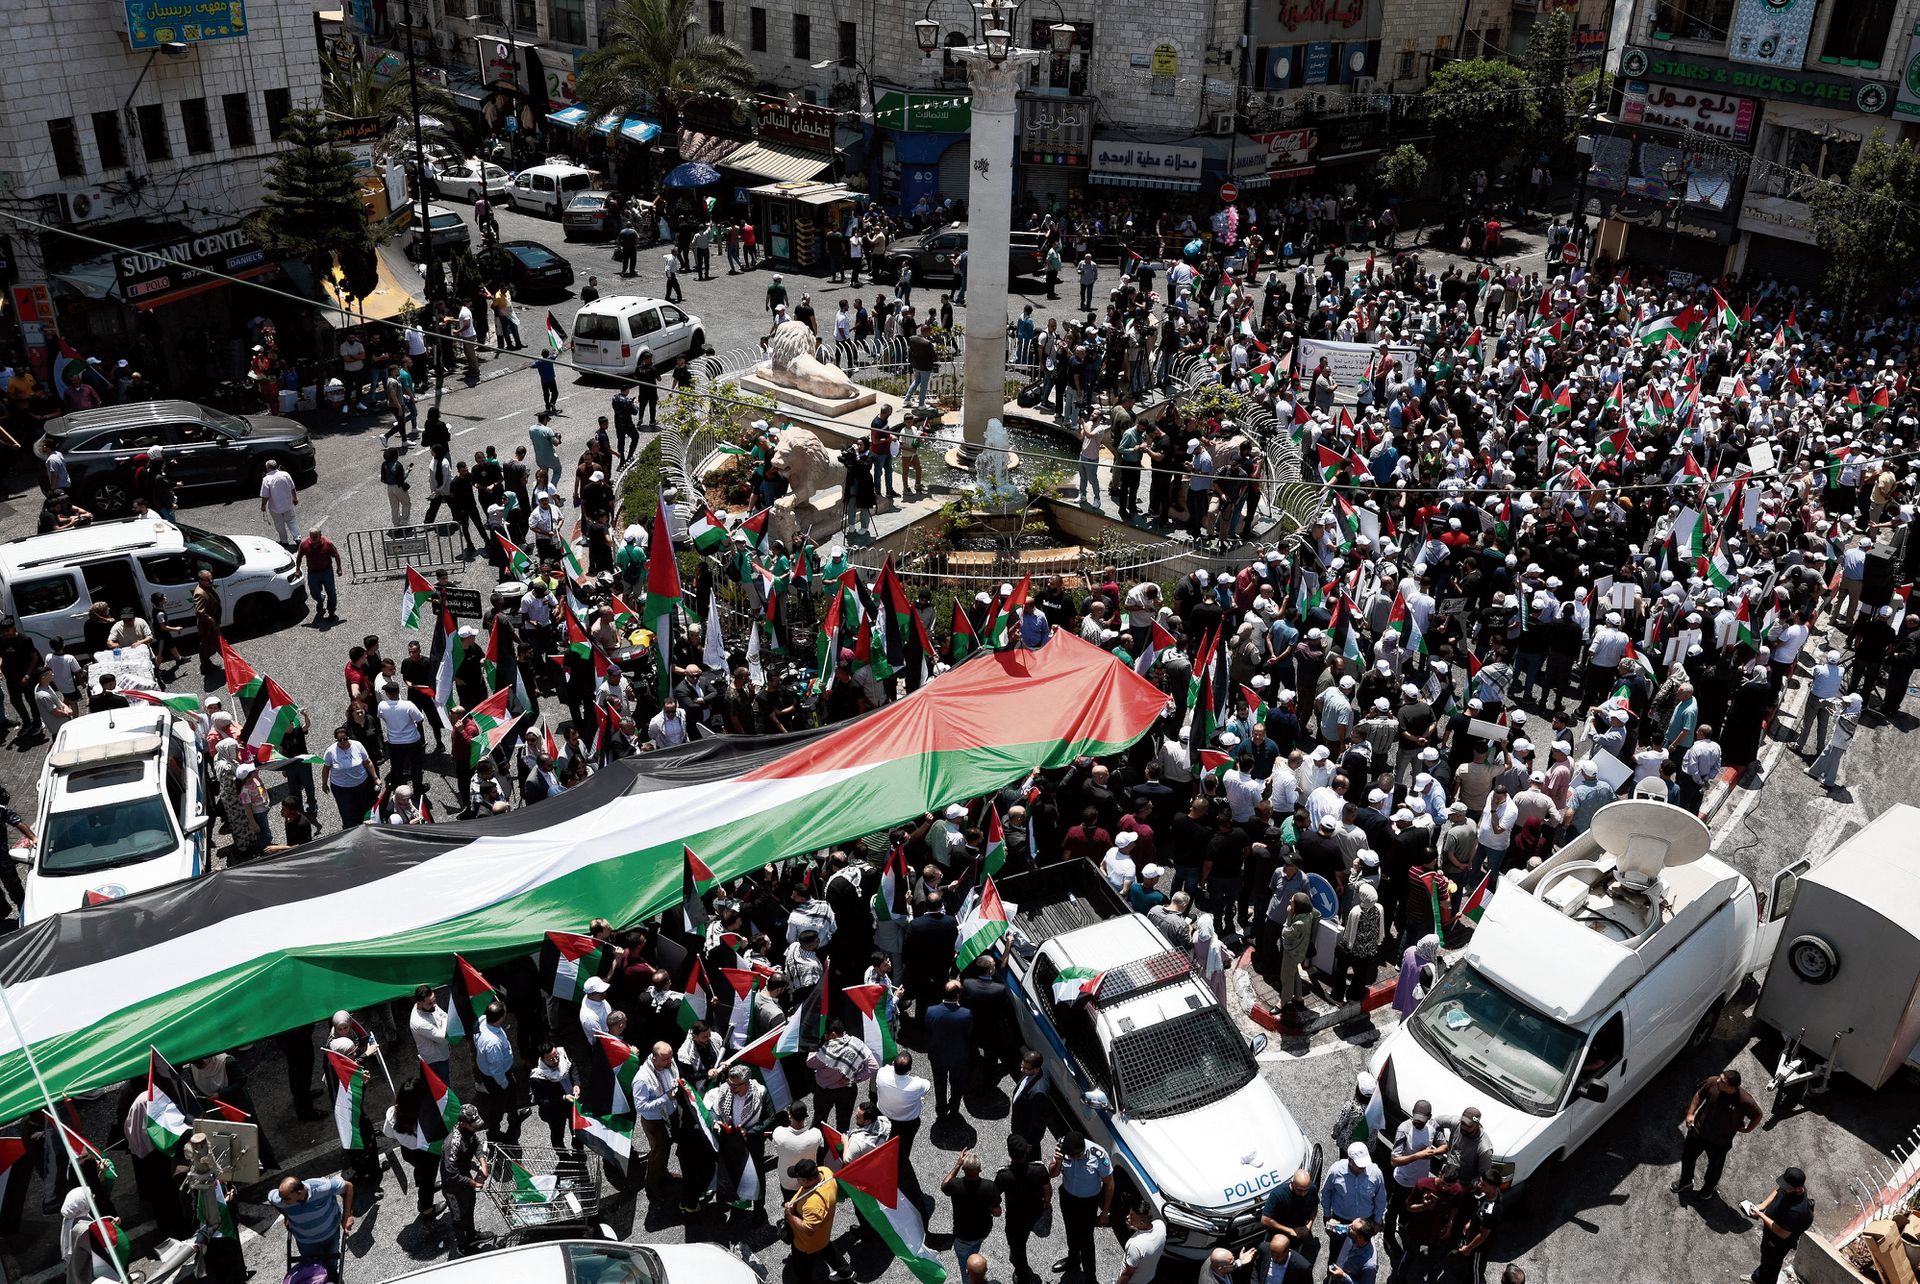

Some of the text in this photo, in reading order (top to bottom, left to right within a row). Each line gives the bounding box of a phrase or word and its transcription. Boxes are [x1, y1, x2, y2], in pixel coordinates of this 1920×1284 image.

[1653, 60, 1710, 81] STARS
[1714, 68, 1728, 84] &
[1732, 71, 1797, 94] BUCKS
[1647, 87, 1696, 108] مول
[1697, 95, 1735, 119] دلع
[1692, 120, 1732, 138] MALL
[1136, 152, 1161, 167] عطية
[1163, 155, 1197, 171] محلات
[121, 228, 255, 277] SUDANI CENTE
[230, 252, 264, 268] DANIEL'S
[146, 279, 169, 292] POLO
[1224, 1170, 1281, 1202] POLICE
